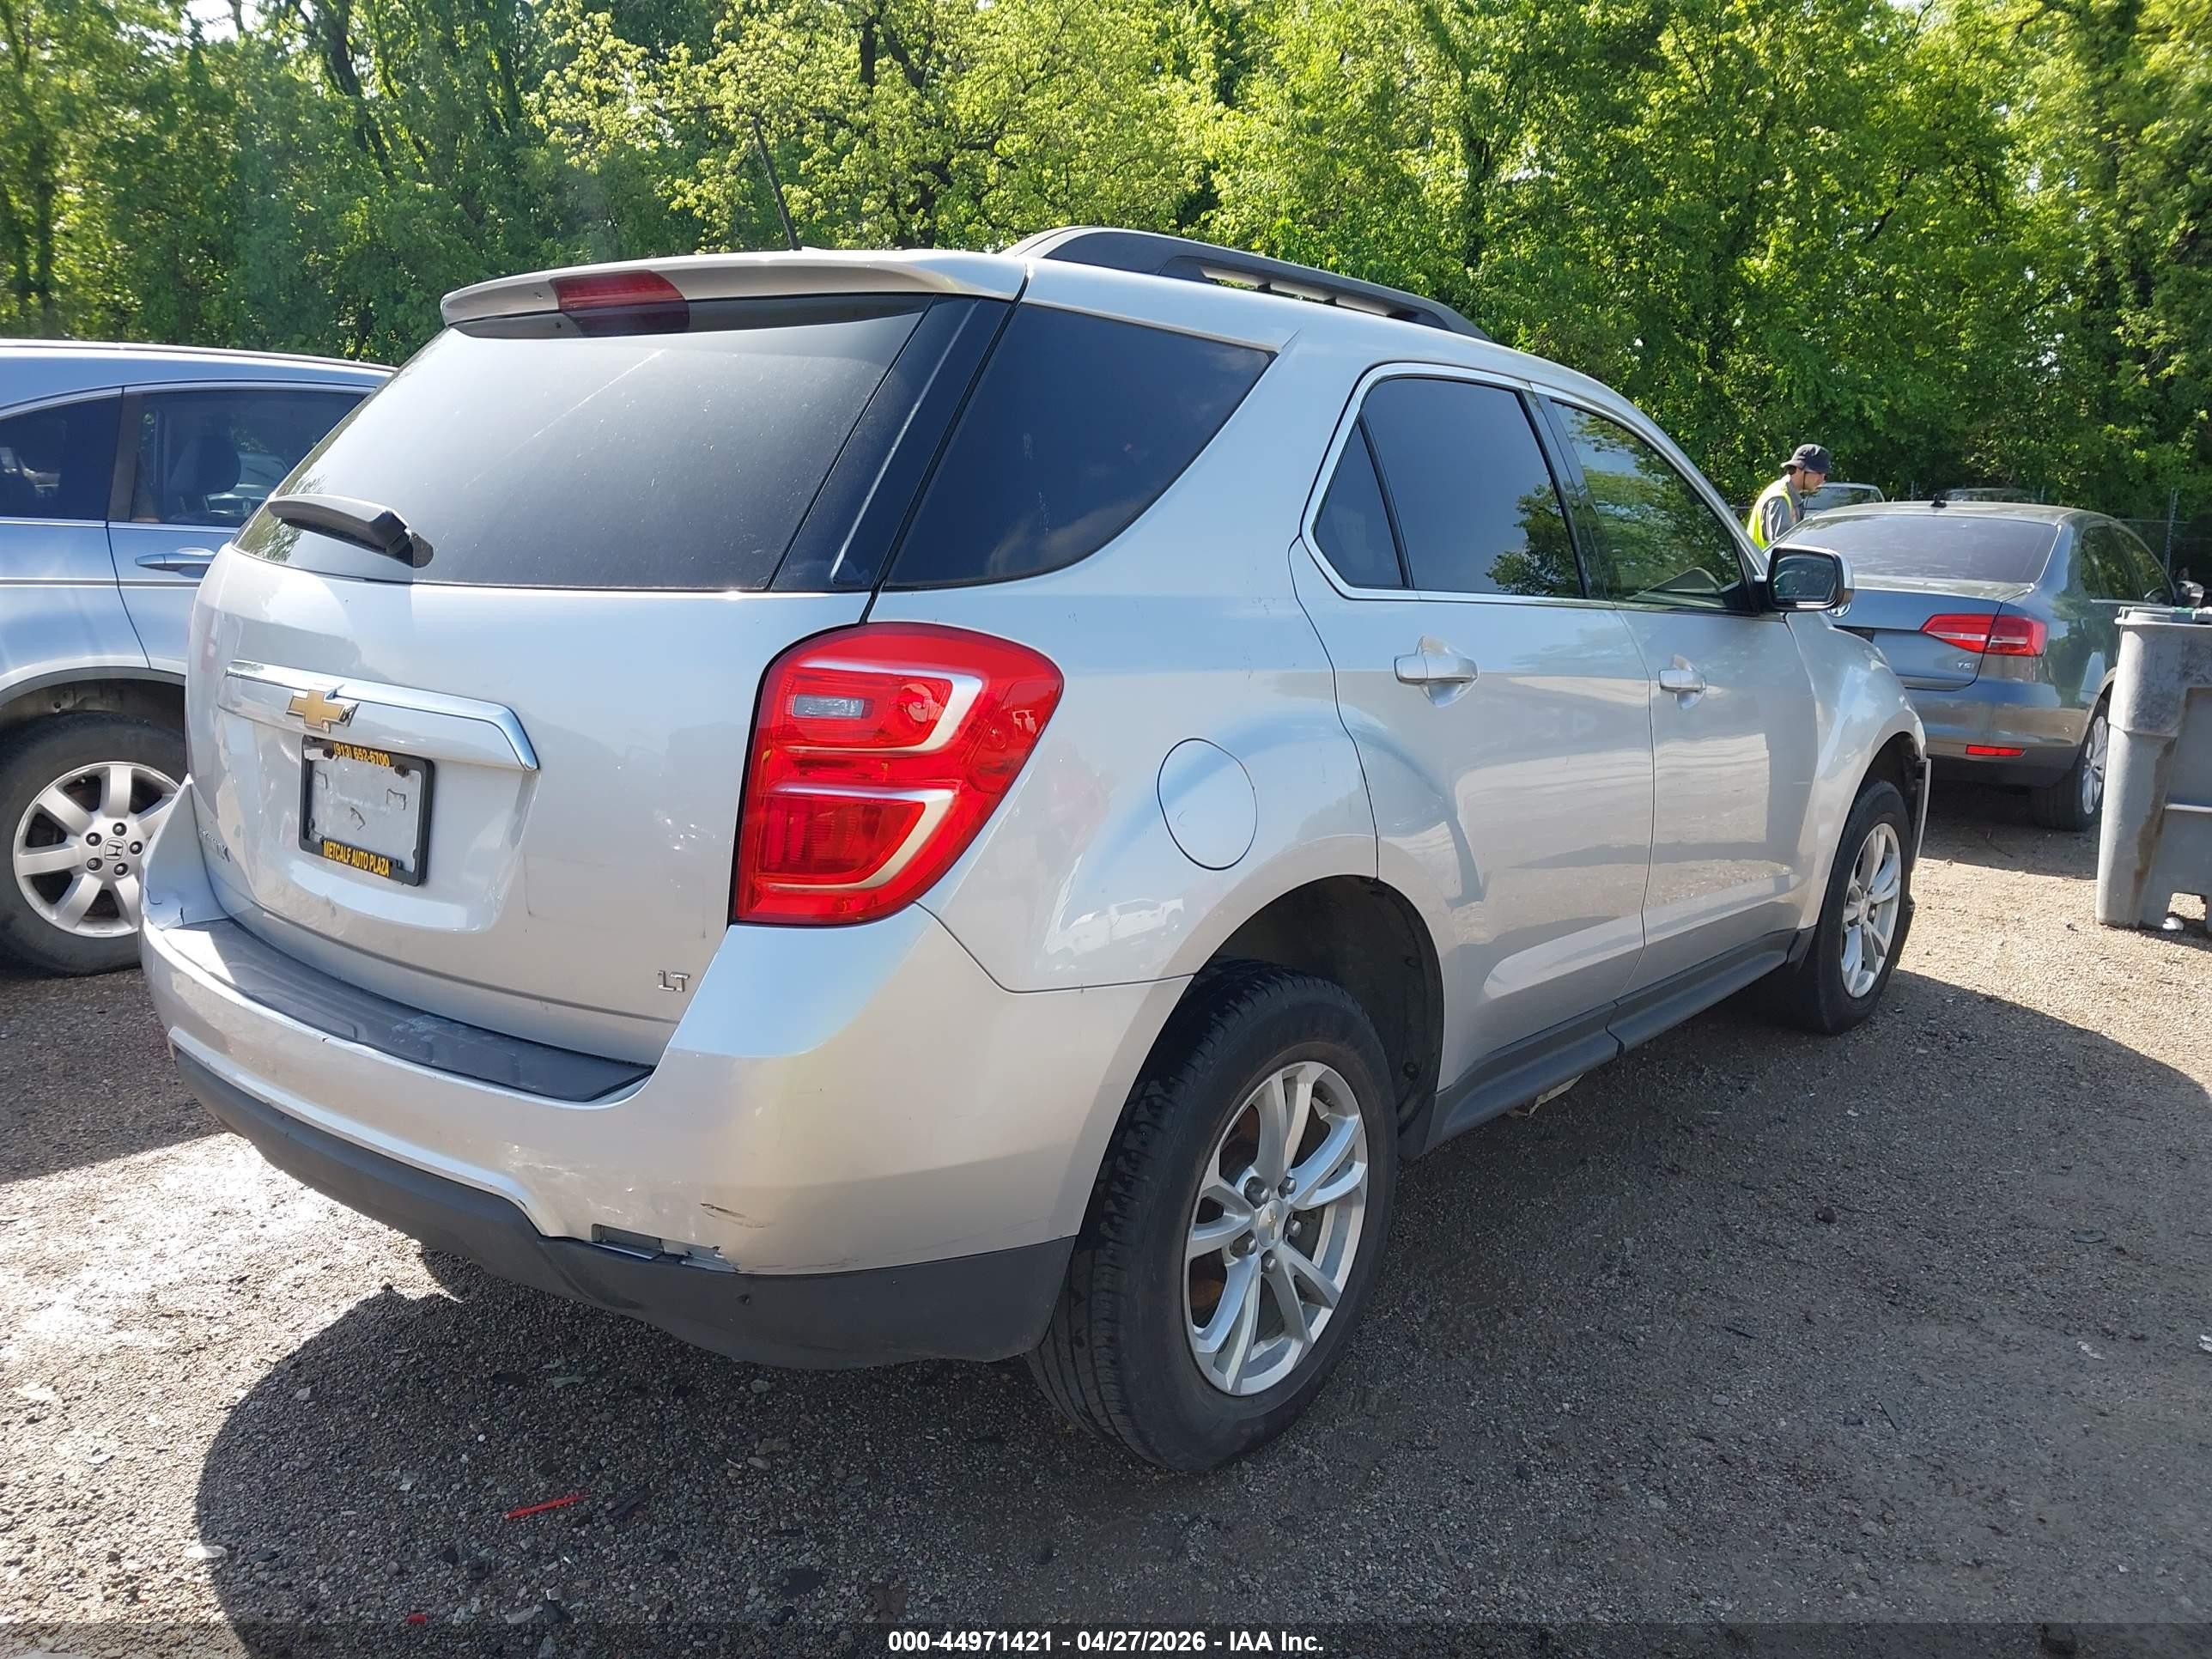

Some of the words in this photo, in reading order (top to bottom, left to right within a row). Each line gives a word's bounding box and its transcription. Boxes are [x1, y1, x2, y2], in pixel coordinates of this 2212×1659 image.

[333, 741, 352, 759] (913)
[353, 746, 391, 767] 652-6700
[323, 840, 352, 864] METCALF
[351, 849, 368, 870] AUTO
[369, 854, 390, 877] PLAZA
[658, 970, 690, 992] LT
